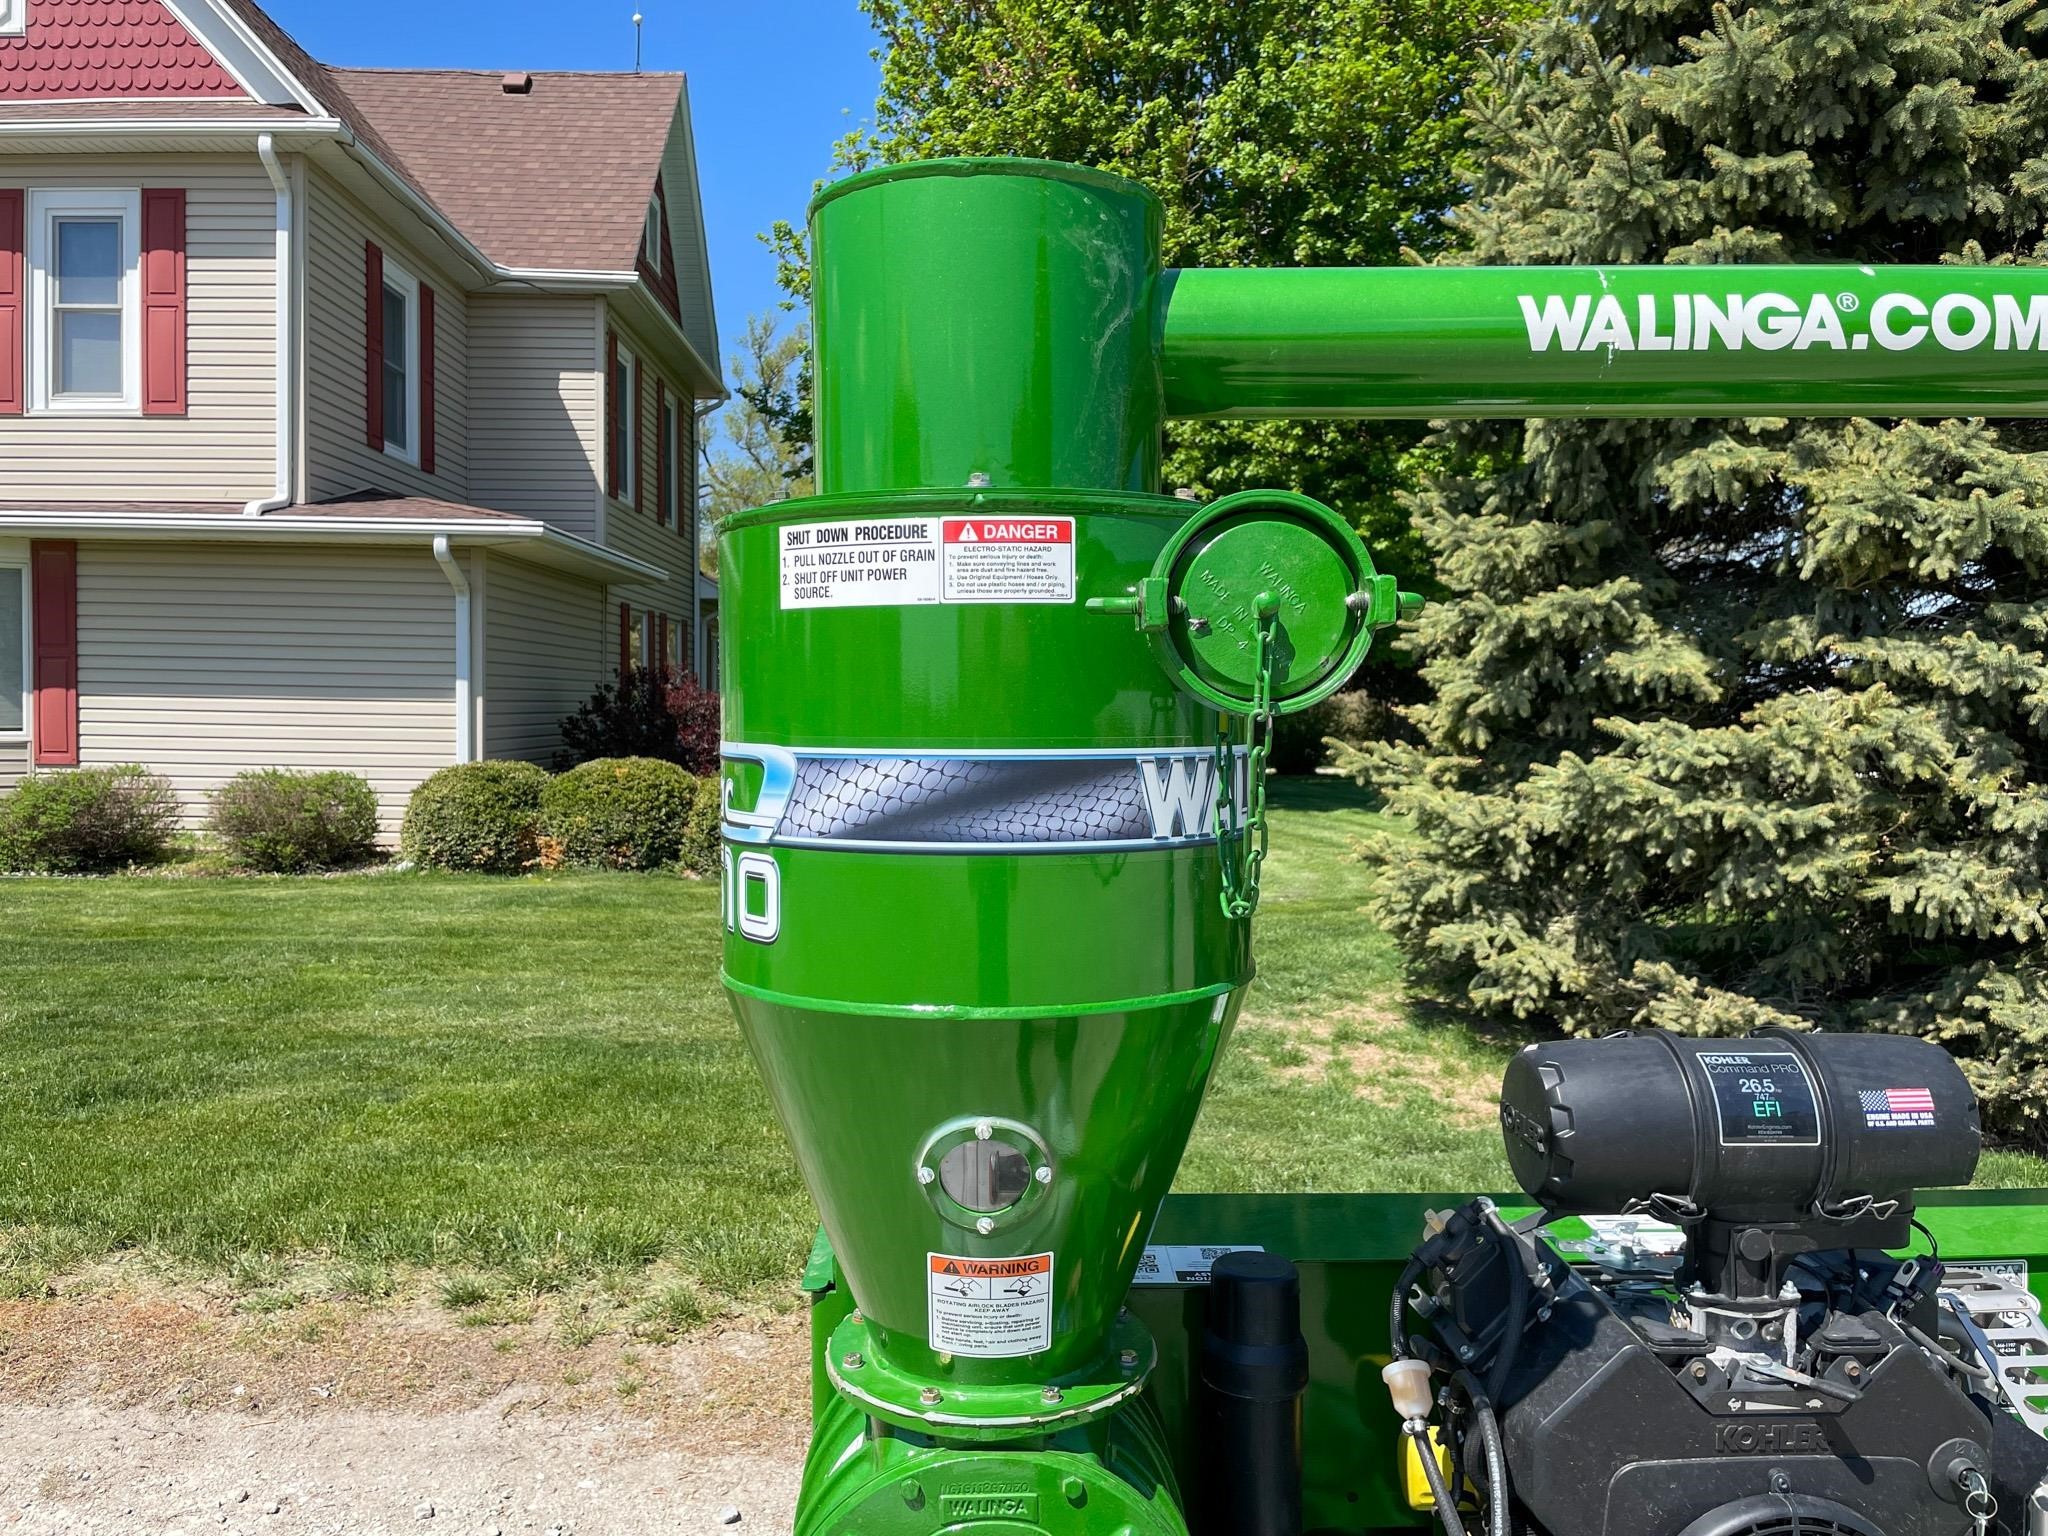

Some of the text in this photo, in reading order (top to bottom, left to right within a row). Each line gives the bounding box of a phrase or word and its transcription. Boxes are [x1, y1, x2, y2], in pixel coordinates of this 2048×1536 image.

[787, 524, 928, 545] SHUT DOWN PROCEDURE
[984, 524, 1058, 539] DANGER
[783, 549, 935, 568] 1. PULL NOZZLE OUT OF GRAIN
[783, 568, 907, 585] 2. SHUT OFF UNIT POWER
[795, 586, 833, 599] SOURCE.
[1260, 561, 1307, 615] WALINGA
[1702, 1056, 1751, 1064] KOHLER
[1708, 1064, 1799, 1073] Command PRO
[1739, 1079, 1775, 1092] 26.5
[1753, 1101, 1781, 1117] EFI
[963, 1260, 1039, 1275] WARNING
[937, 1299, 966, 1307] ROTATING
[1714, 1424, 1829, 1452] KOHLER
[949, 1499, 1028, 1516] WALINGA
